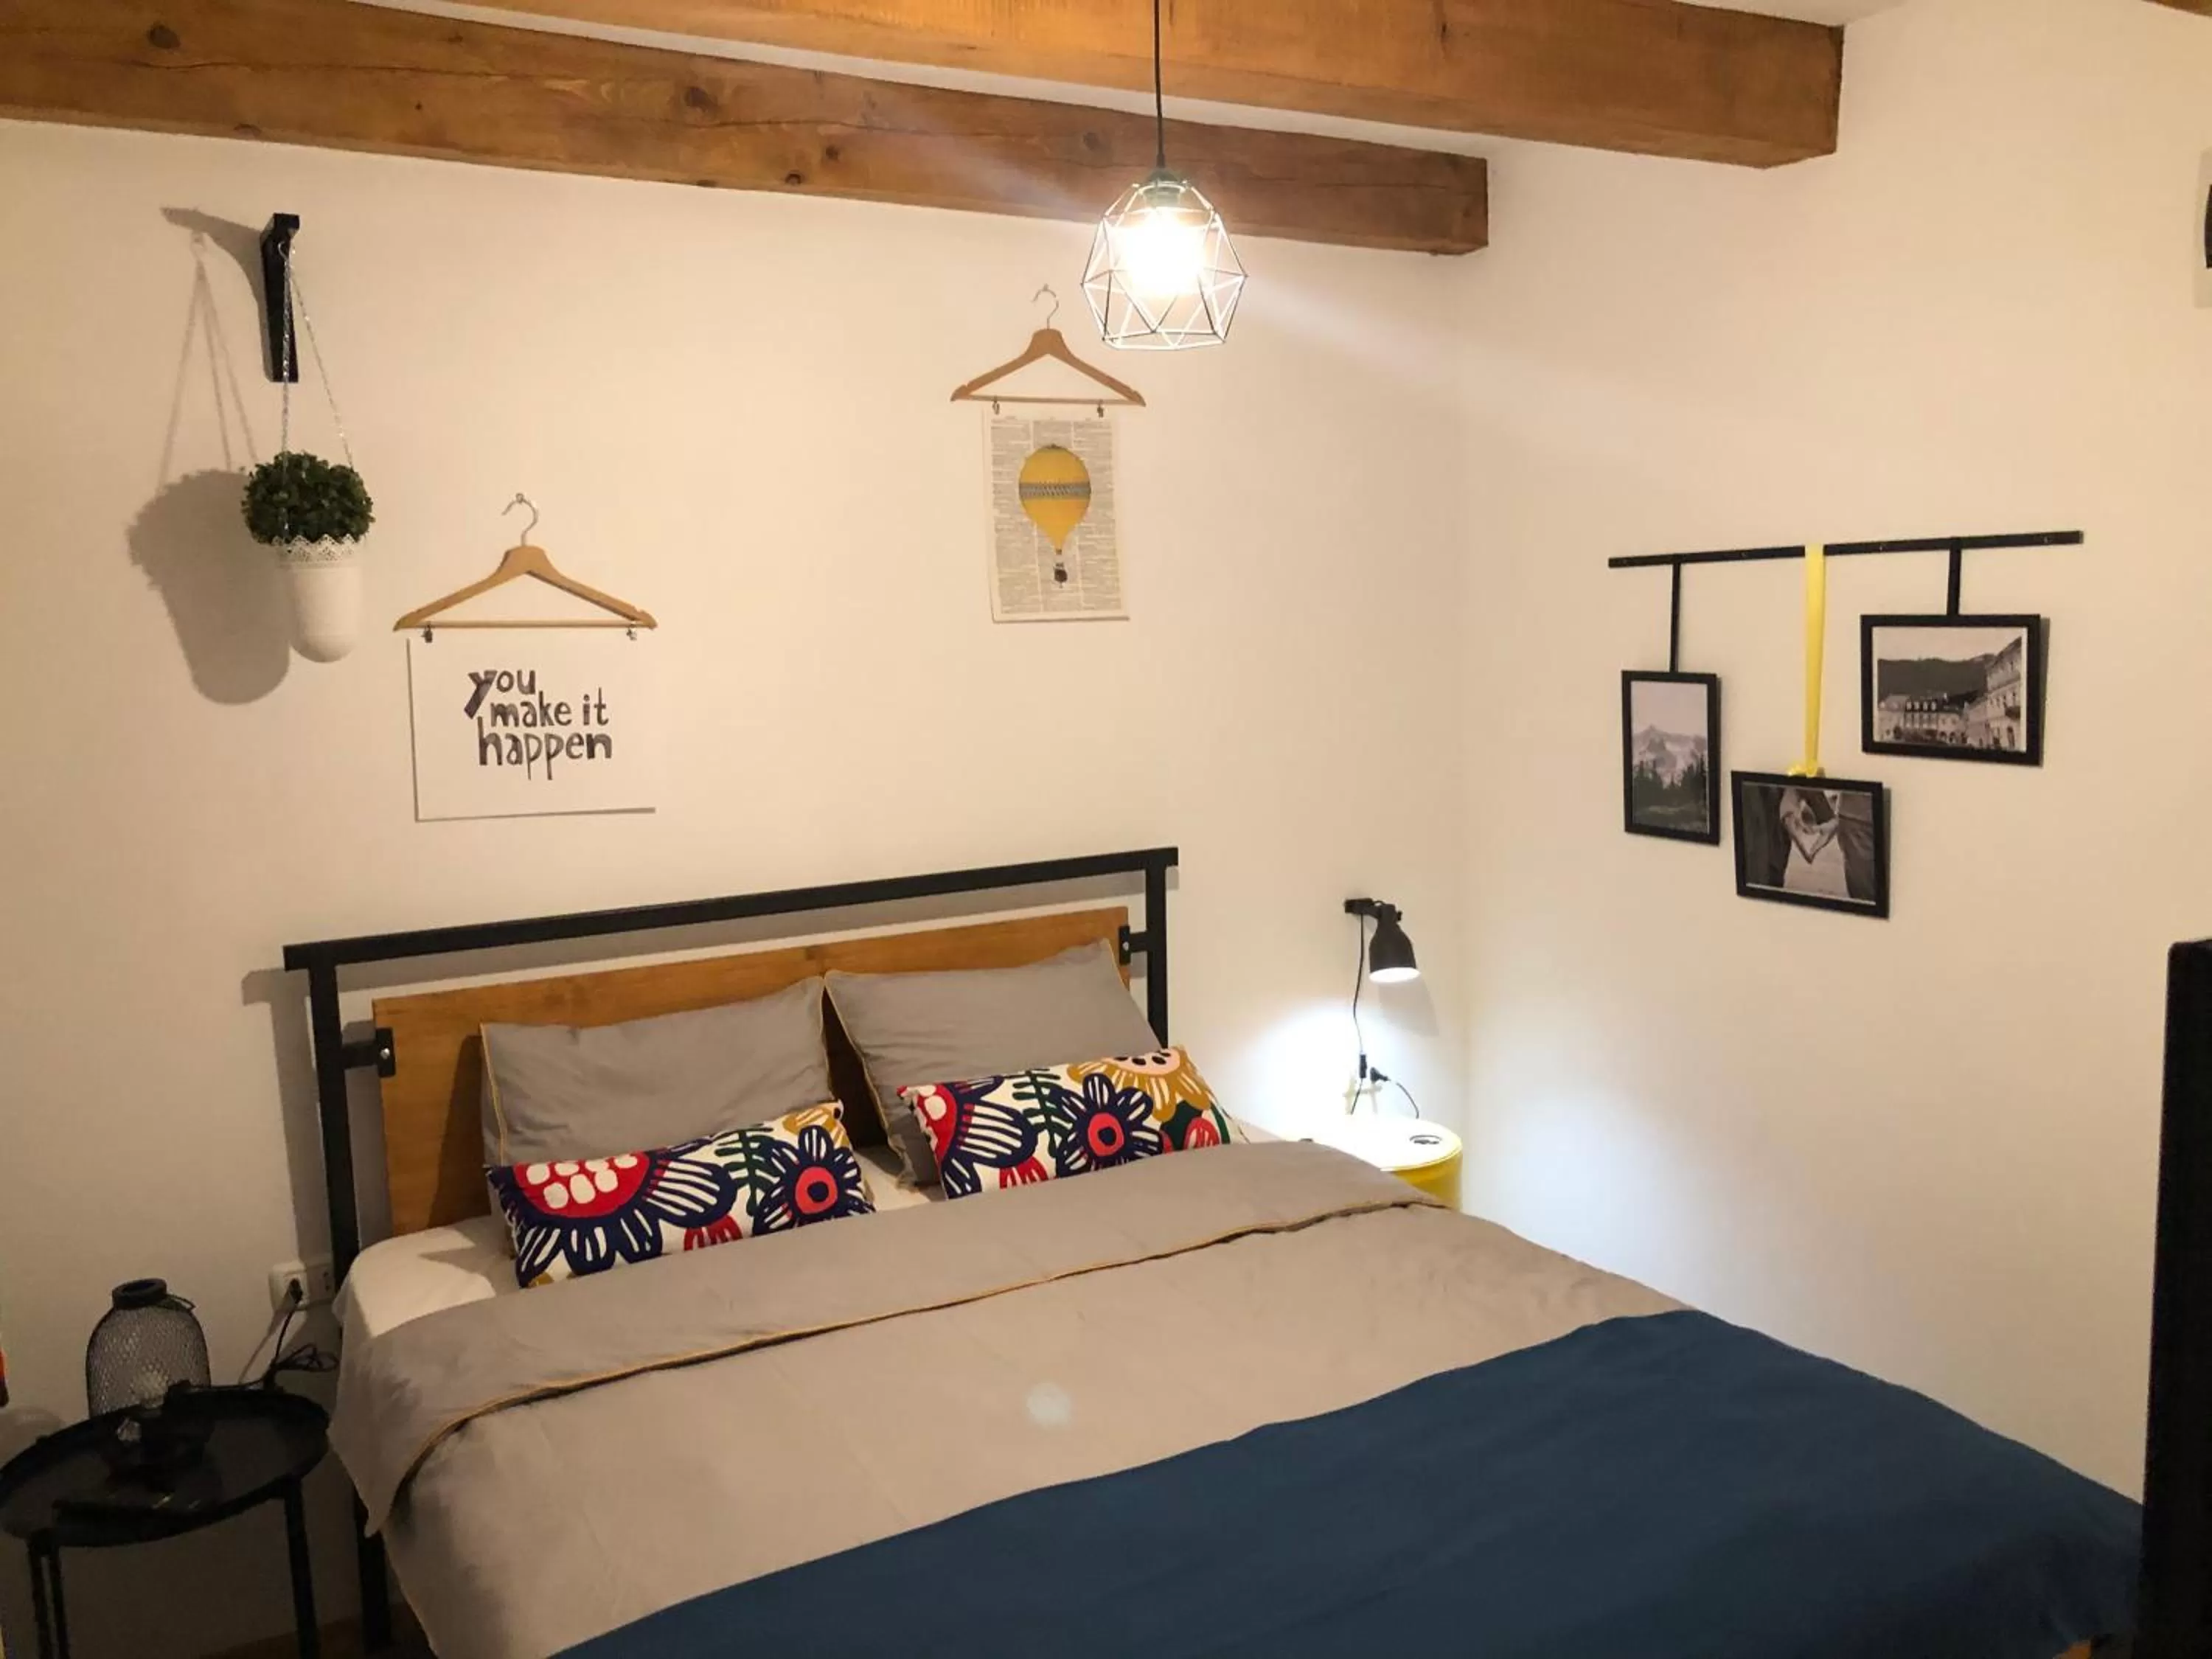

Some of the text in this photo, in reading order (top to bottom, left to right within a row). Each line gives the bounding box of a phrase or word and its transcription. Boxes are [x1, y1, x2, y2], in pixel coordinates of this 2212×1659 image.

[465, 669, 536, 719] you
[491, 687, 609, 727] make it
[478, 716, 612, 780] happen
